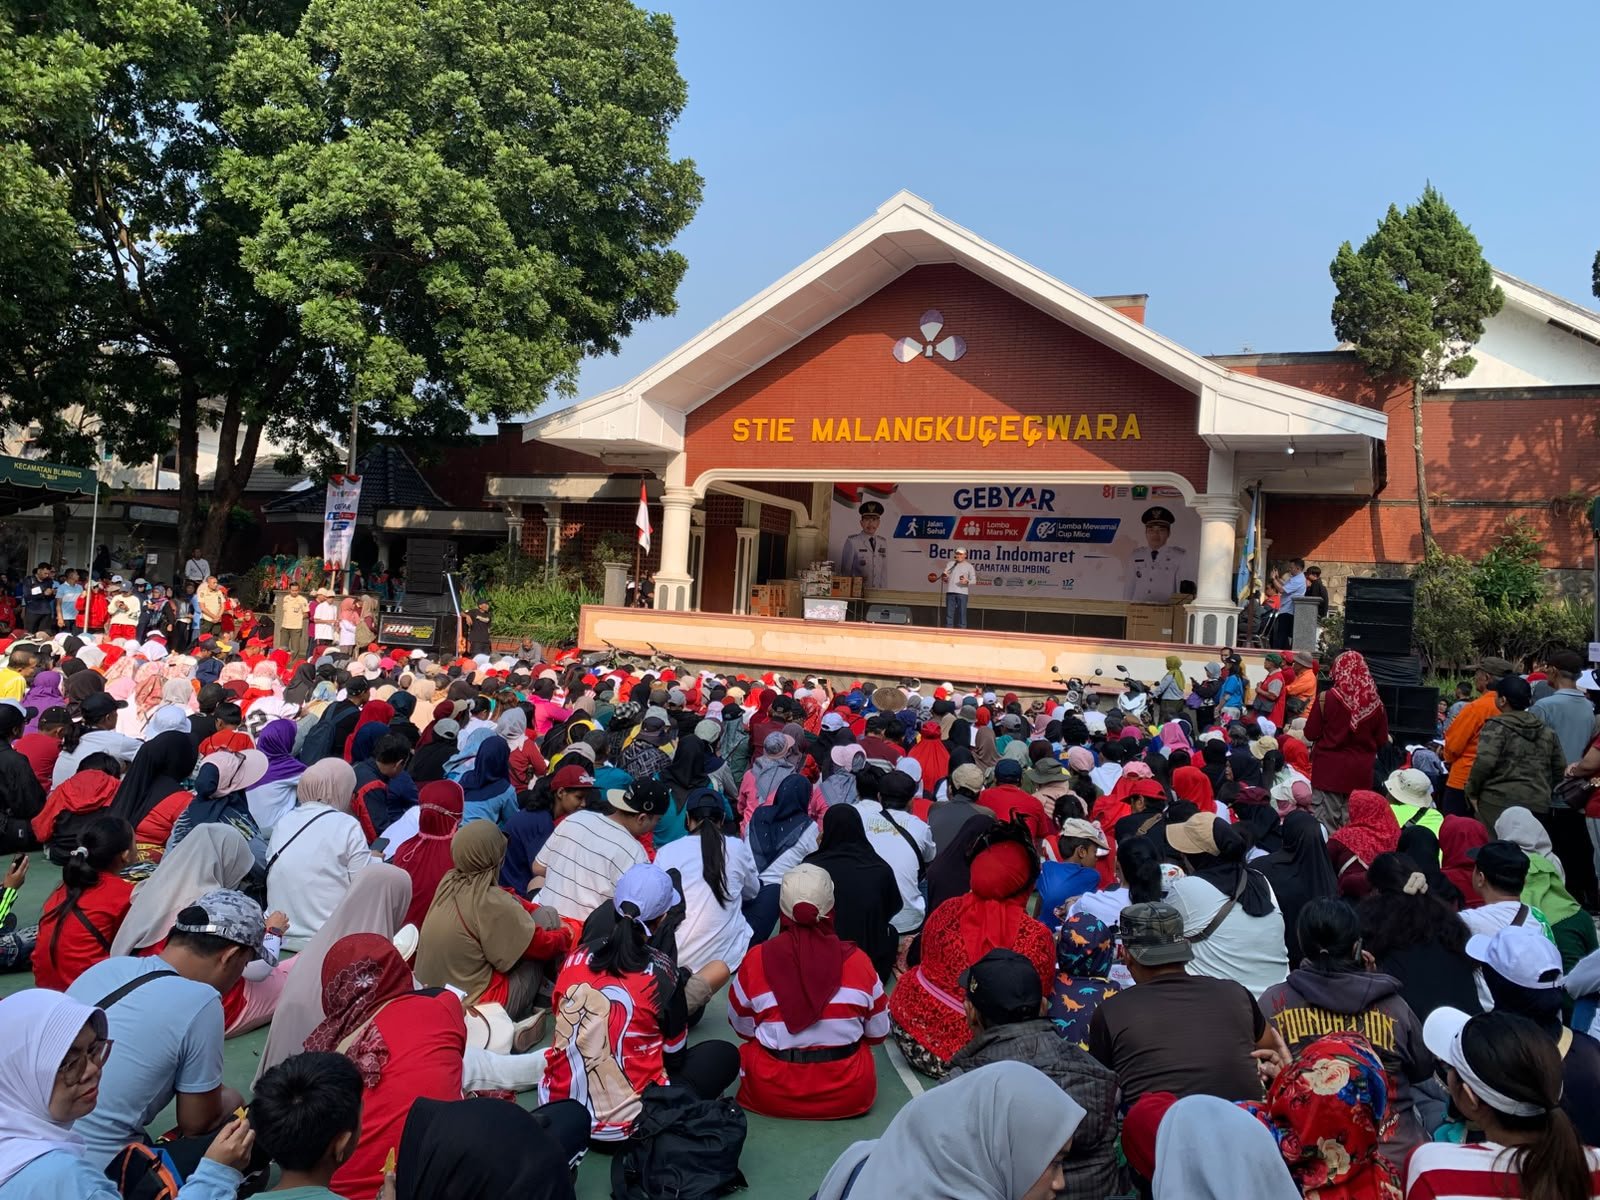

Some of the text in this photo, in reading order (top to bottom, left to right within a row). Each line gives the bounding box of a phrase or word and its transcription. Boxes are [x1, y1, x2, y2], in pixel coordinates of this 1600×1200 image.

[733, 413, 1141, 447] STIE MALANGKUÇEÇWARA
[14, 462, 82, 479] KECAMATAN BLIMBING
[953, 486, 1055, 511] GEBYAR
[927, 520, 944, 528] Jalan
[986, 521, 1010, 529] Lomba
[1058, 522, 1118, 531] Lomba Mewarnai
[926, 527, 946, 535] Sehat
[986, 528, 1003, 536] Mars
[1057, 530, 1091, 538] Cup Mice
[996, 545, 1076, 564] Indomaret
[1012, 564, 1051, 574] BLIMBING
